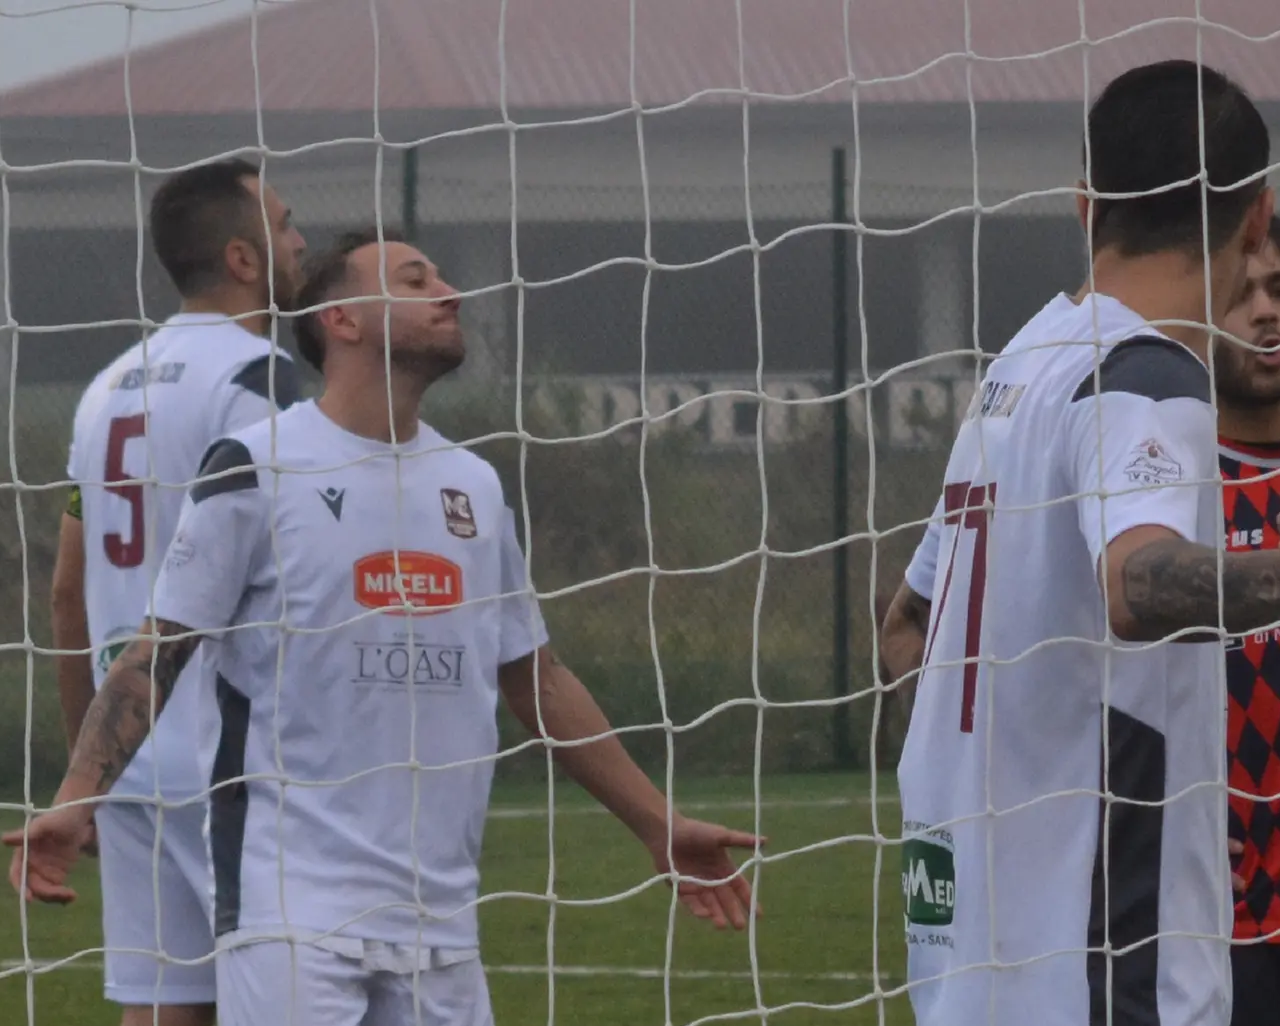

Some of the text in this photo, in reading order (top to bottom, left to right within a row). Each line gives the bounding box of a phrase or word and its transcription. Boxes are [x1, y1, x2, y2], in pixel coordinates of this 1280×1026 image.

[103, 412, 150, 569] 5
[364, 572, 453, 595] MICELI
[919, 481, 997, 733] 71
[357, 648, 465, 681] L'OASI
